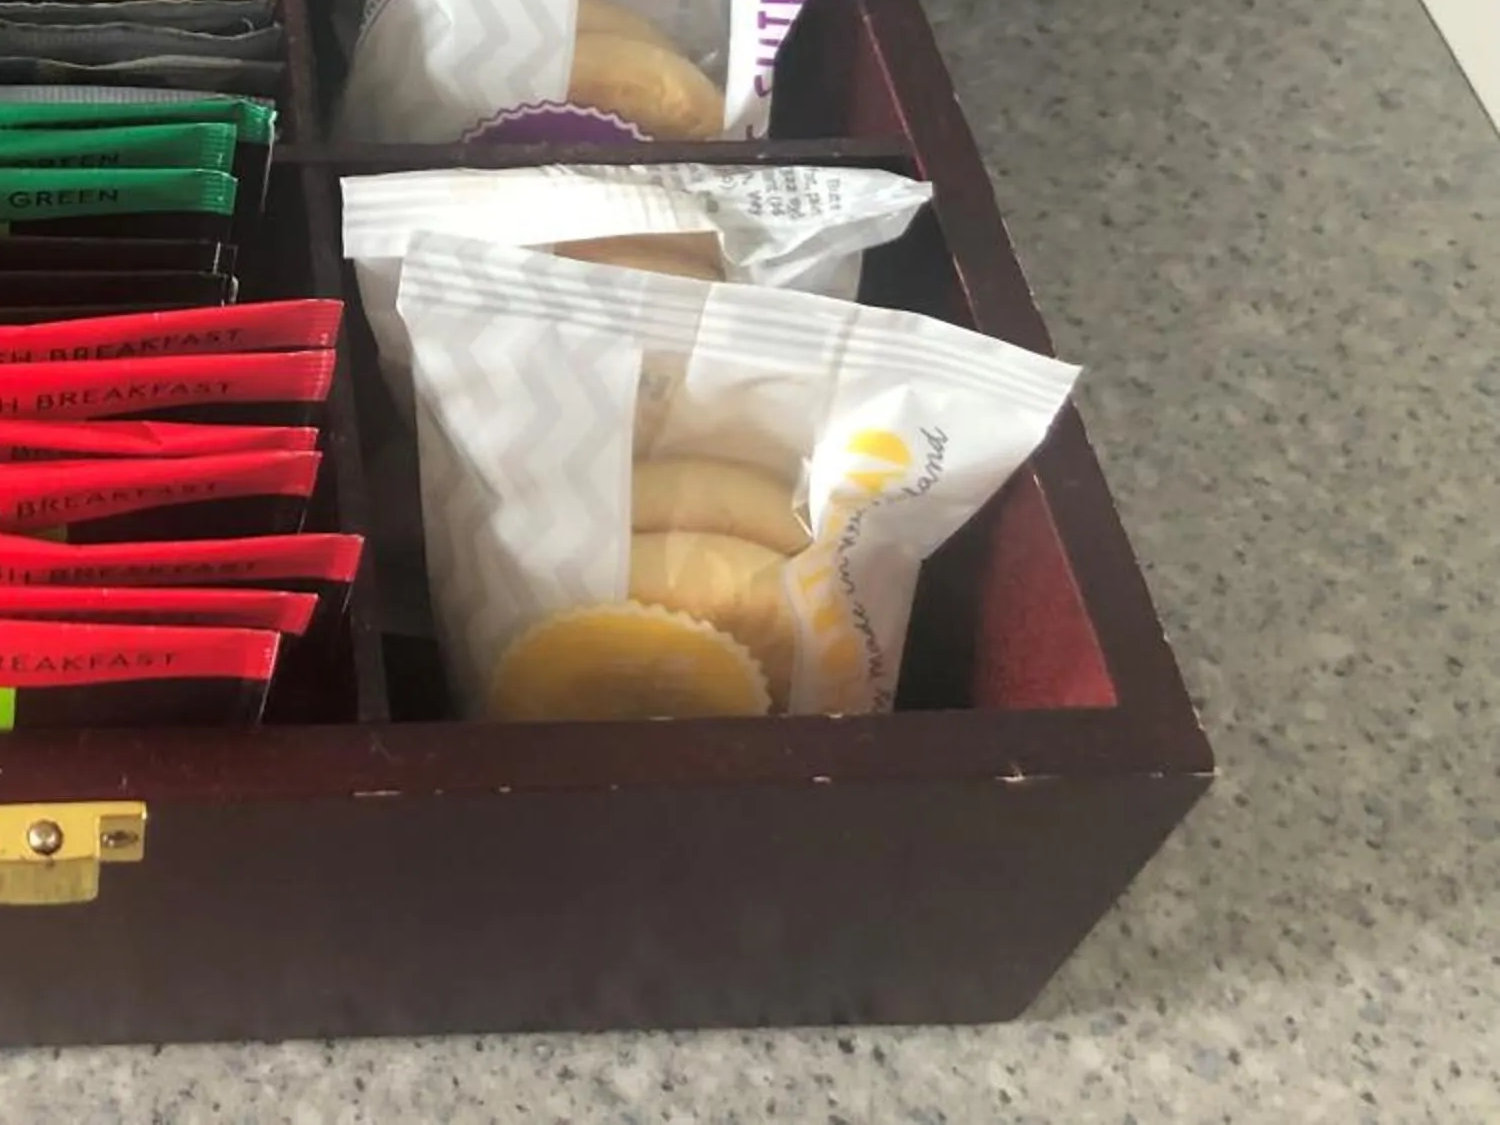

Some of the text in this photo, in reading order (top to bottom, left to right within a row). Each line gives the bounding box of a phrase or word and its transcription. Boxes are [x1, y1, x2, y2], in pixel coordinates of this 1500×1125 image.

[8, 188, 119, 209] GREEN
[49, 327, 243, 363] BREAKFAST
[35, 381, 231, 412] BREAKFAST
[15, 480, 218, 521] BREAKFAST
